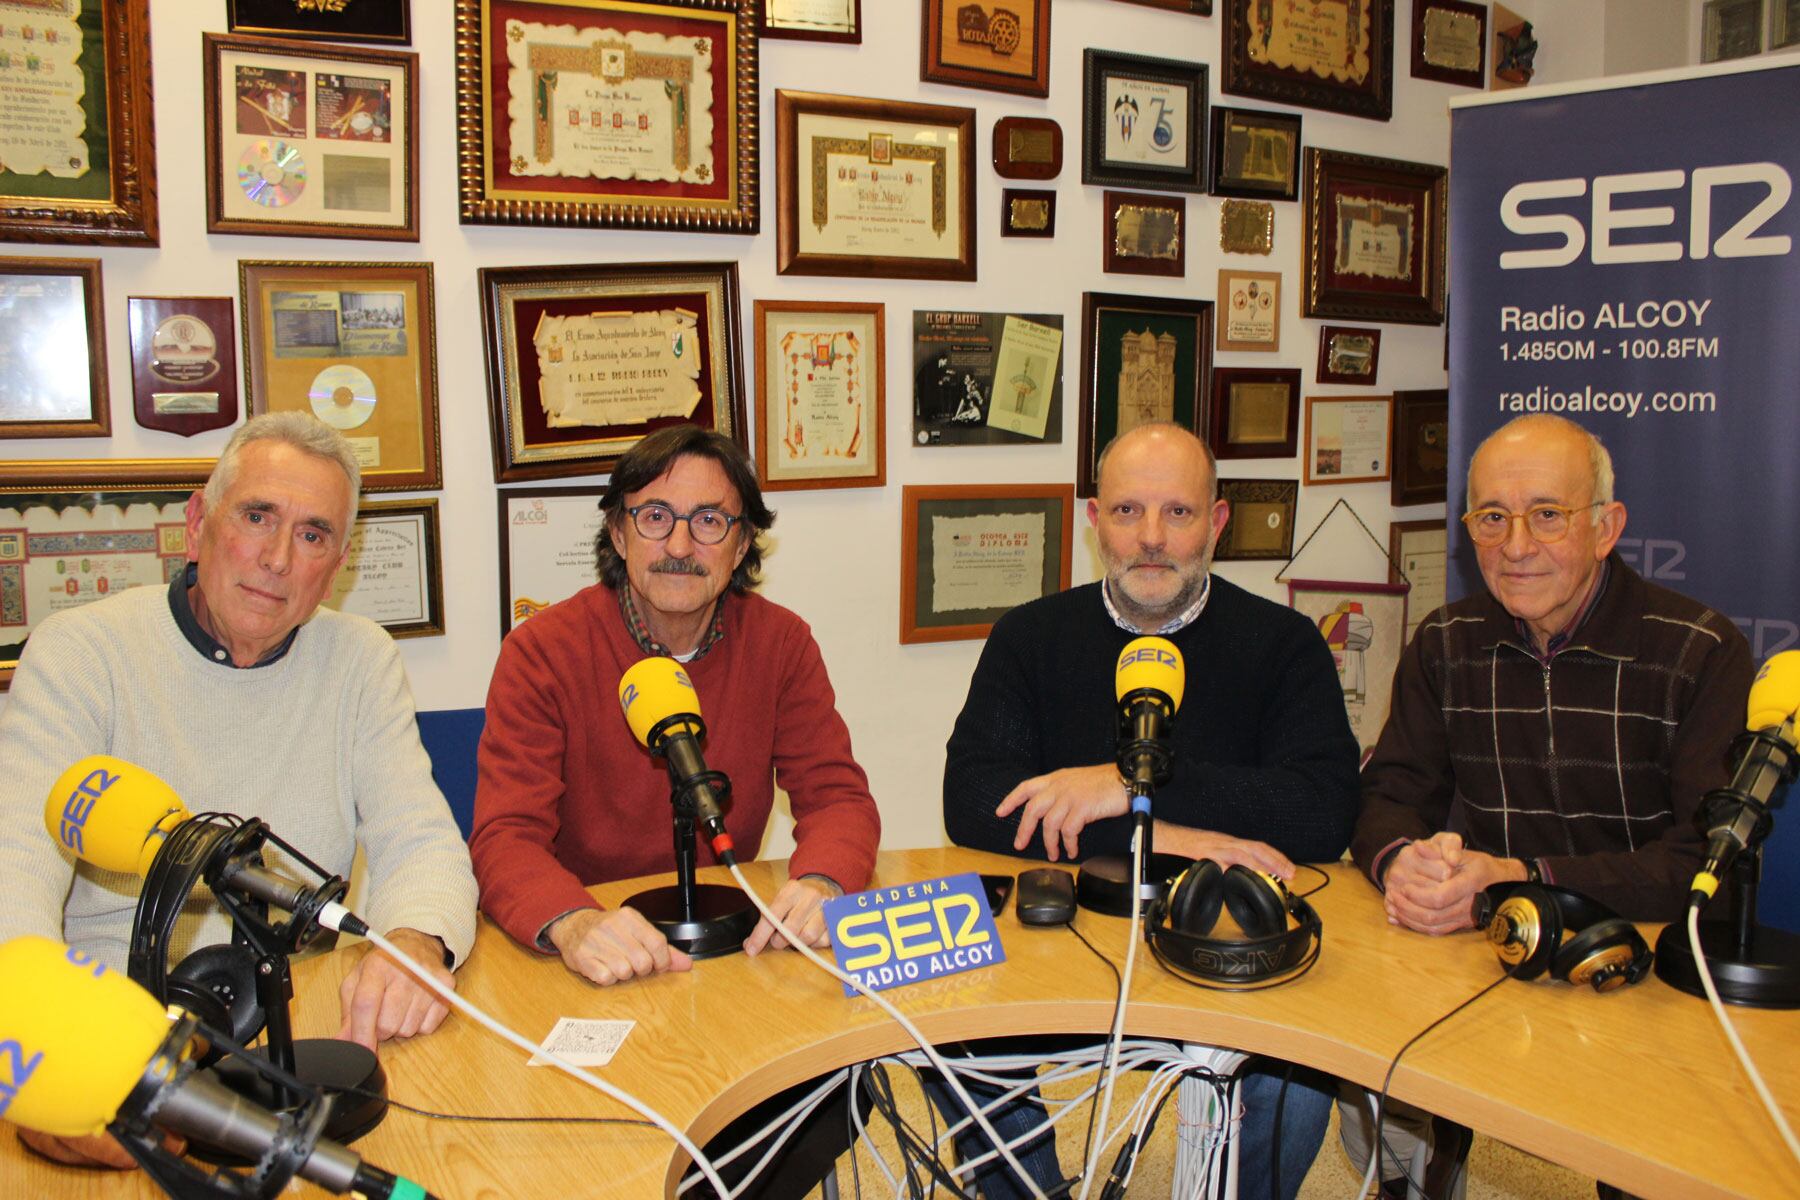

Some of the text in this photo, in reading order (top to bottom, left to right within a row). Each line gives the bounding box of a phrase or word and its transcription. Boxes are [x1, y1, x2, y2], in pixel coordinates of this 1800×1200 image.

[1499, 162, 1792, 269] SER
[1501, 299, 1712, 332] Radio ALCOY
[1618, 337, 1719, 359] 100.8FM
[1499, 386, 1716, 417] radioalcoy.com
[1119, 648, 1177, 672] SER
[60, 768, 121, 854] SER
[857, 880, 949, 908] CADENA
[836, 893, 990, 971] SER
[930, 944, 993, 974] ALCOY
